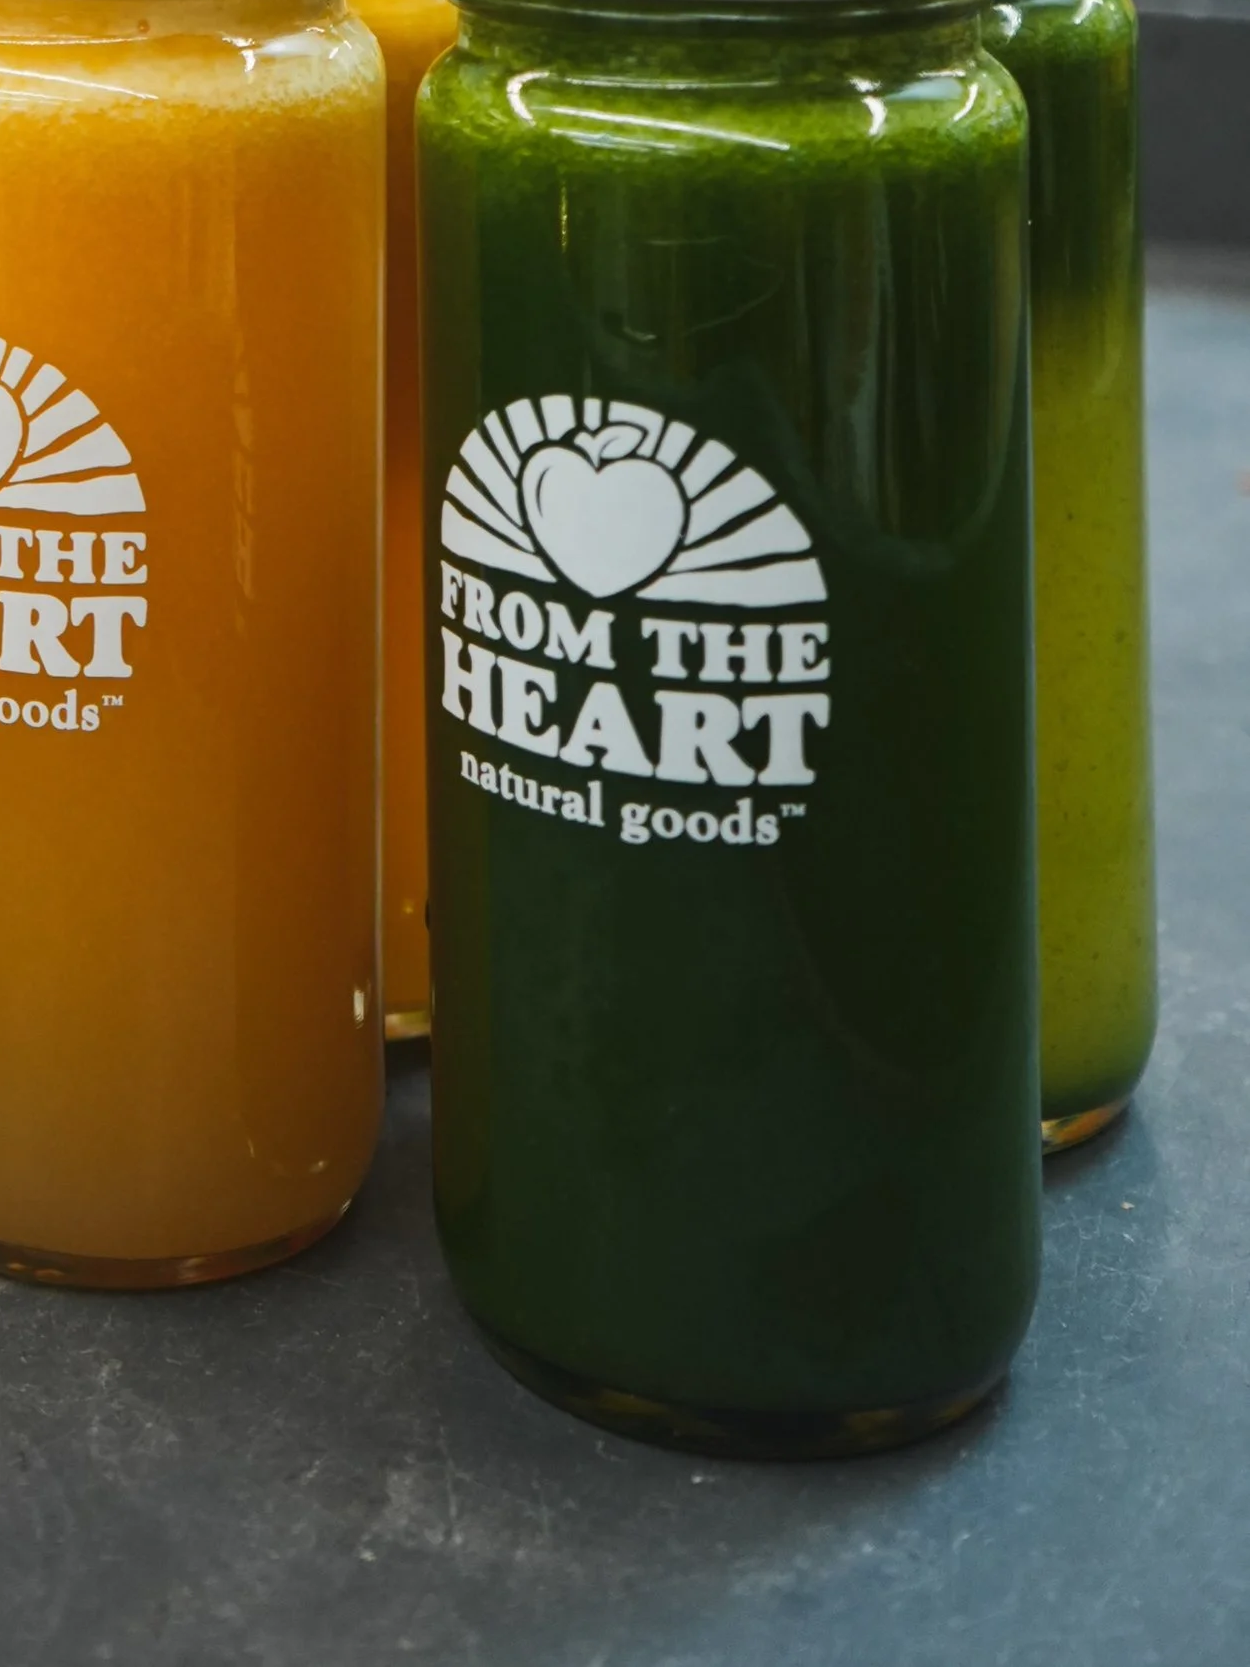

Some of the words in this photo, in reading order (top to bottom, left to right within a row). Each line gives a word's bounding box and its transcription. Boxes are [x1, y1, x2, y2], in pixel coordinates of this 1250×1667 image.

[440, 559, 616, 670] FROM
[641, 617, 831, 683] THE
[440, 625, 831, 787] HEART
[460, 750, 606, 828] natural
